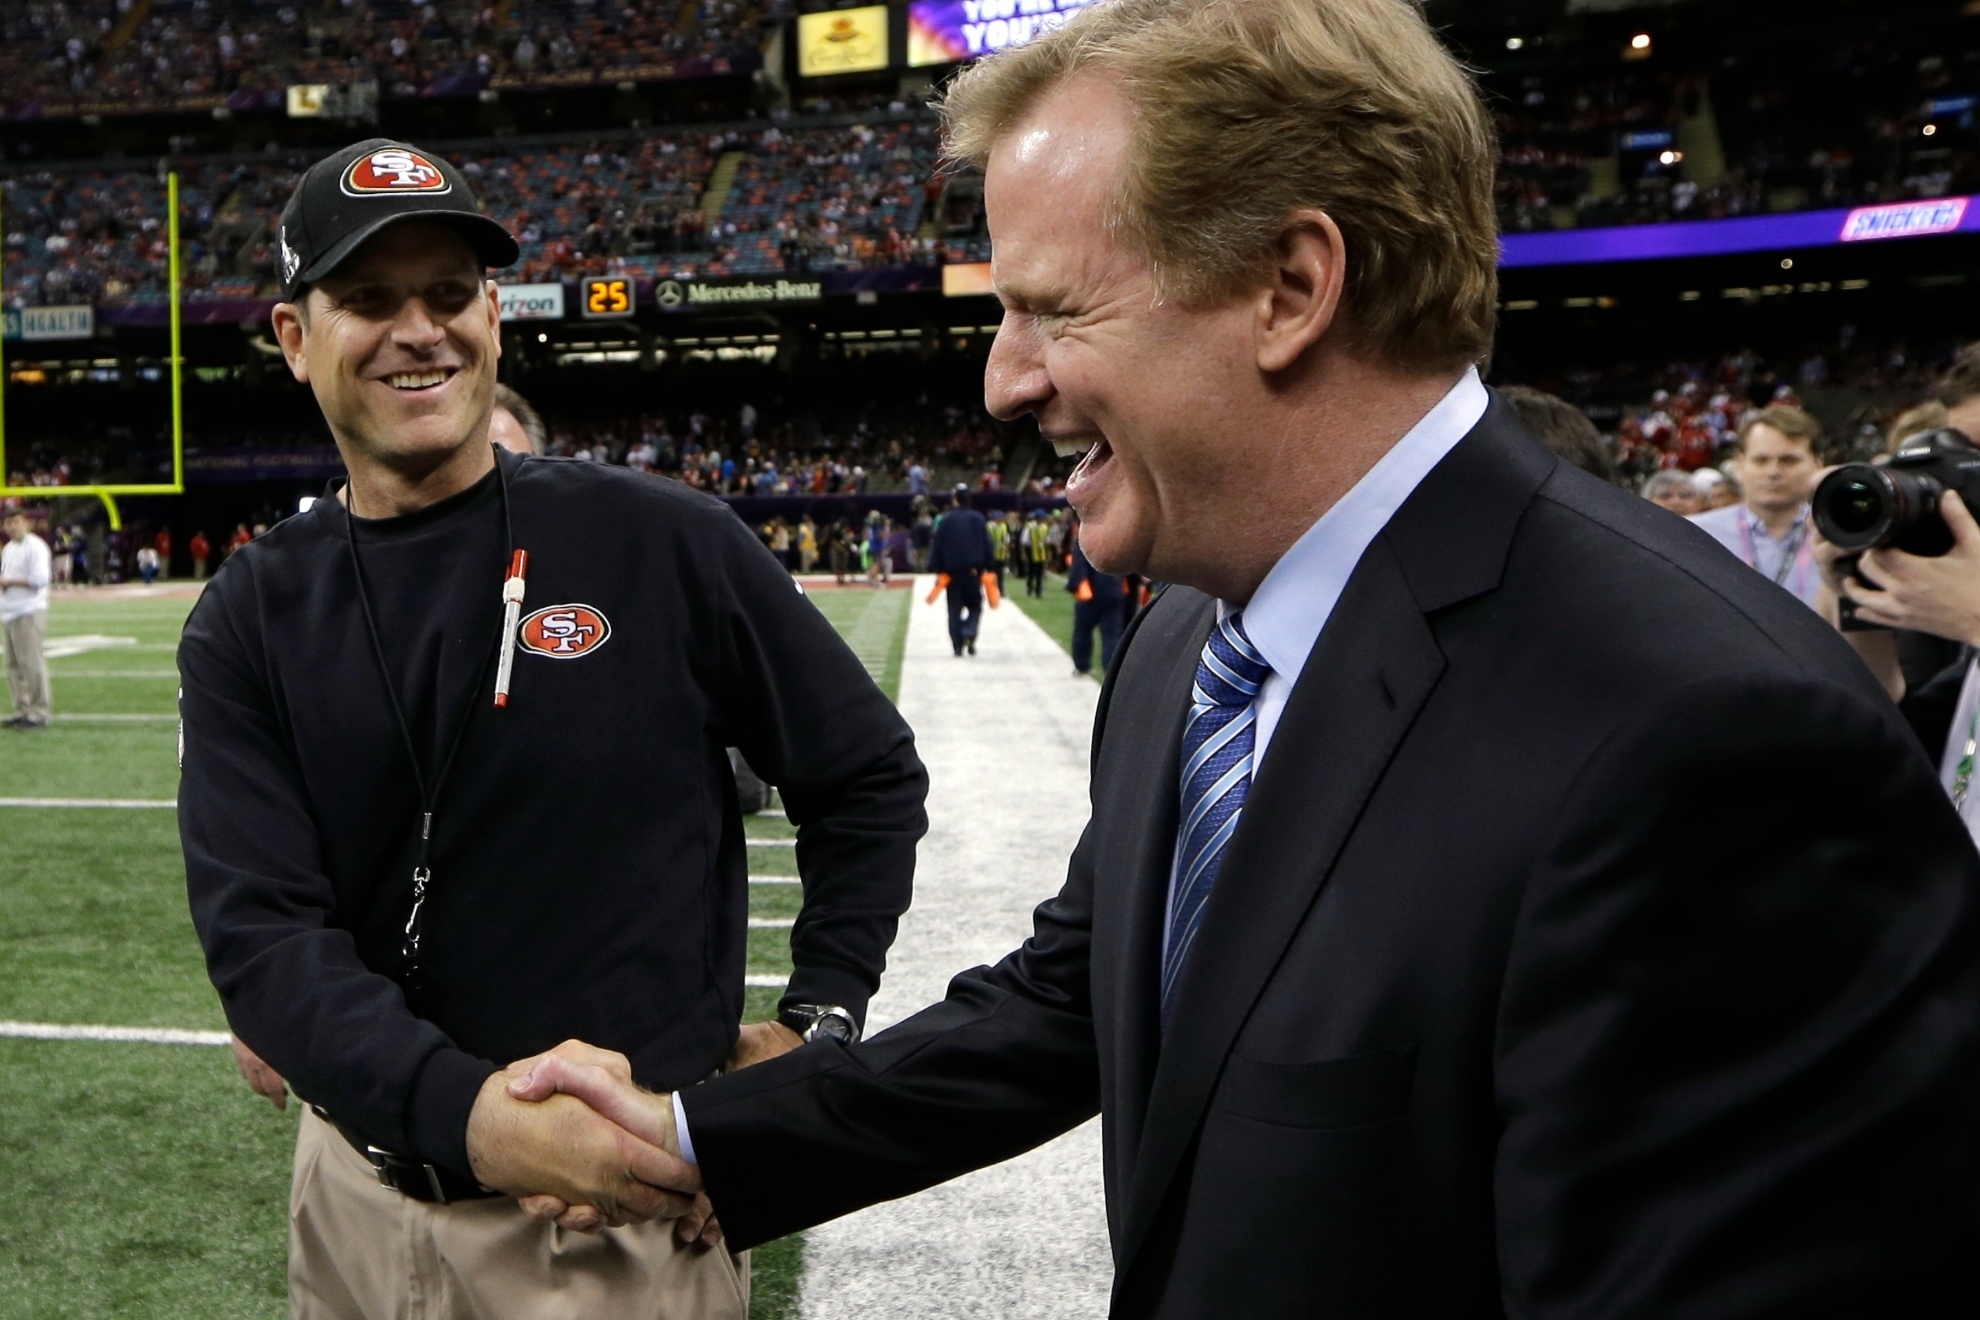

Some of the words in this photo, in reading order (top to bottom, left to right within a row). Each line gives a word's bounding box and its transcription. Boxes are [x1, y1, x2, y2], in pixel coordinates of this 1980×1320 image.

[590, 281, 628, 313] 25
[688, 280, 821, 304] Mercedes-Benz
[542, 612, 593, 652] SF
